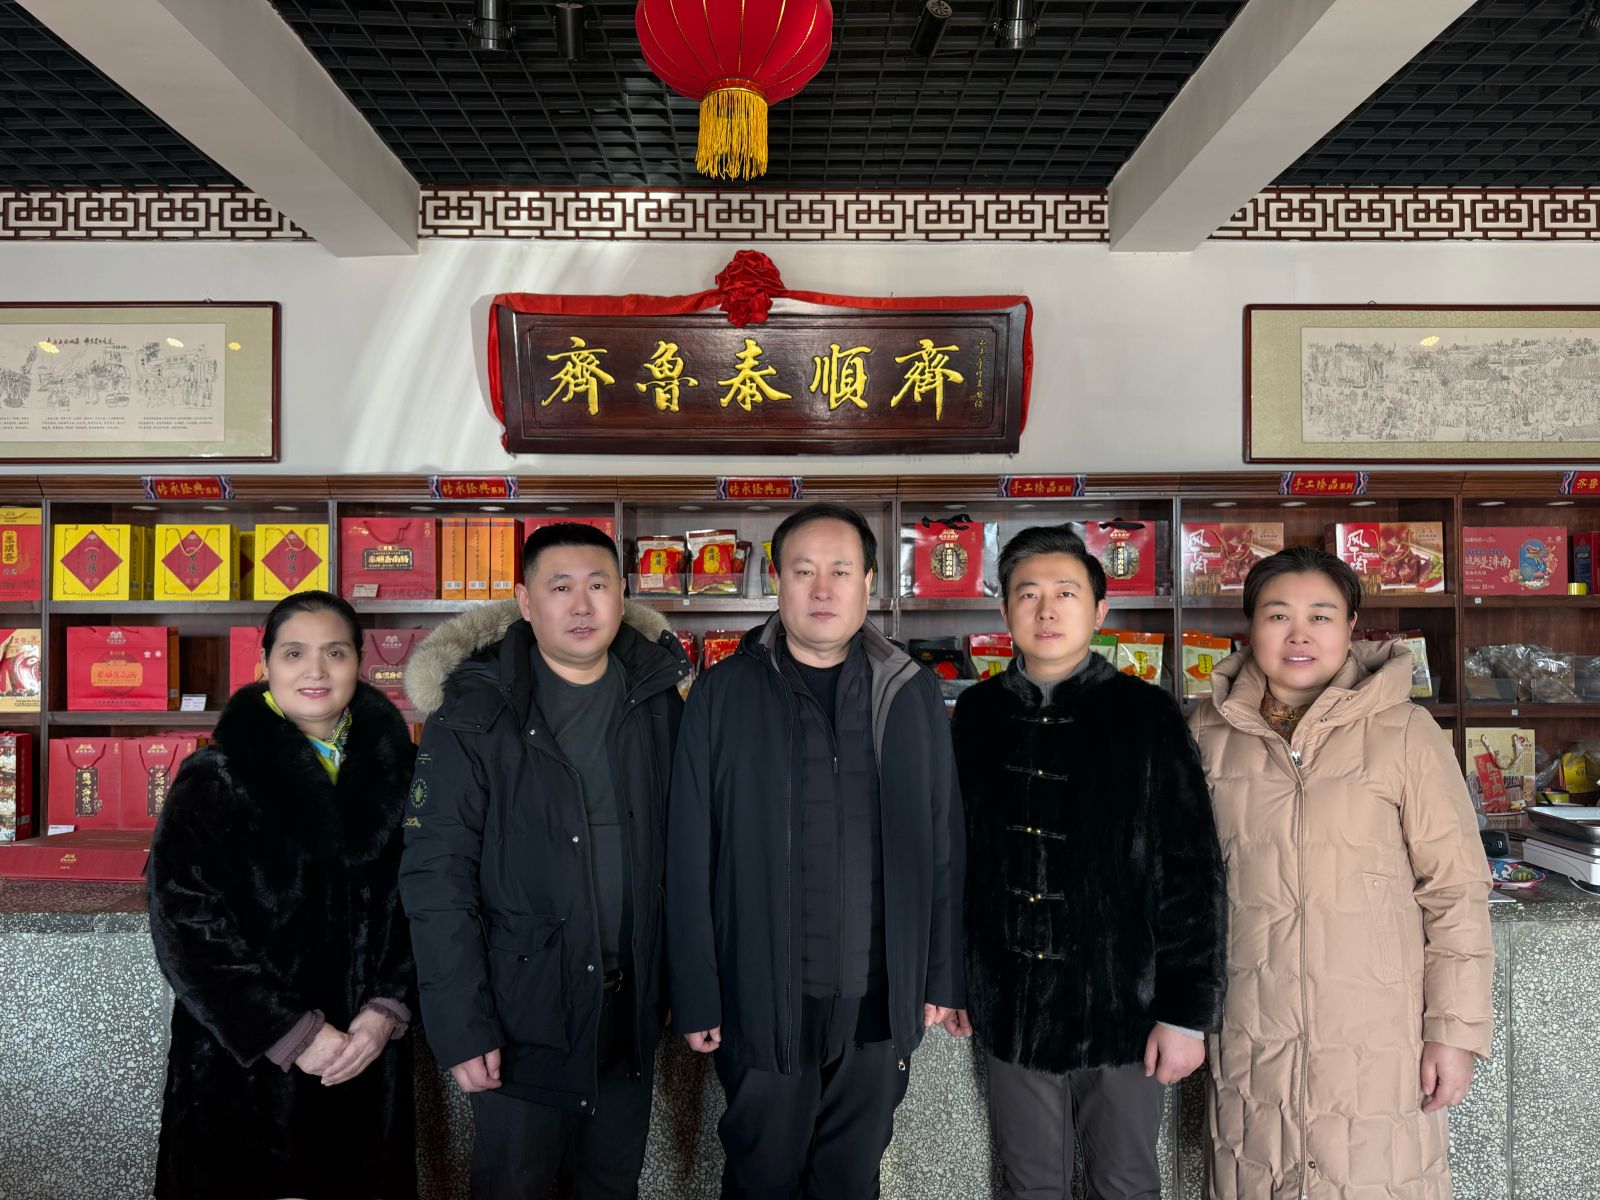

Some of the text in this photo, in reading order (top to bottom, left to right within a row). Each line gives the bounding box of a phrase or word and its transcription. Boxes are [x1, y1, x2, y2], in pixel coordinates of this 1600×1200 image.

[157, 481, 220, 496] 传承经典系列
[442, 481, 505, 495] 传承经典系列
[729, 482, 789, 495] 传承经典系列
[1188, 529, 1210, 574] 风干肉
[1346, 529, 1370, 574] 风干肉
